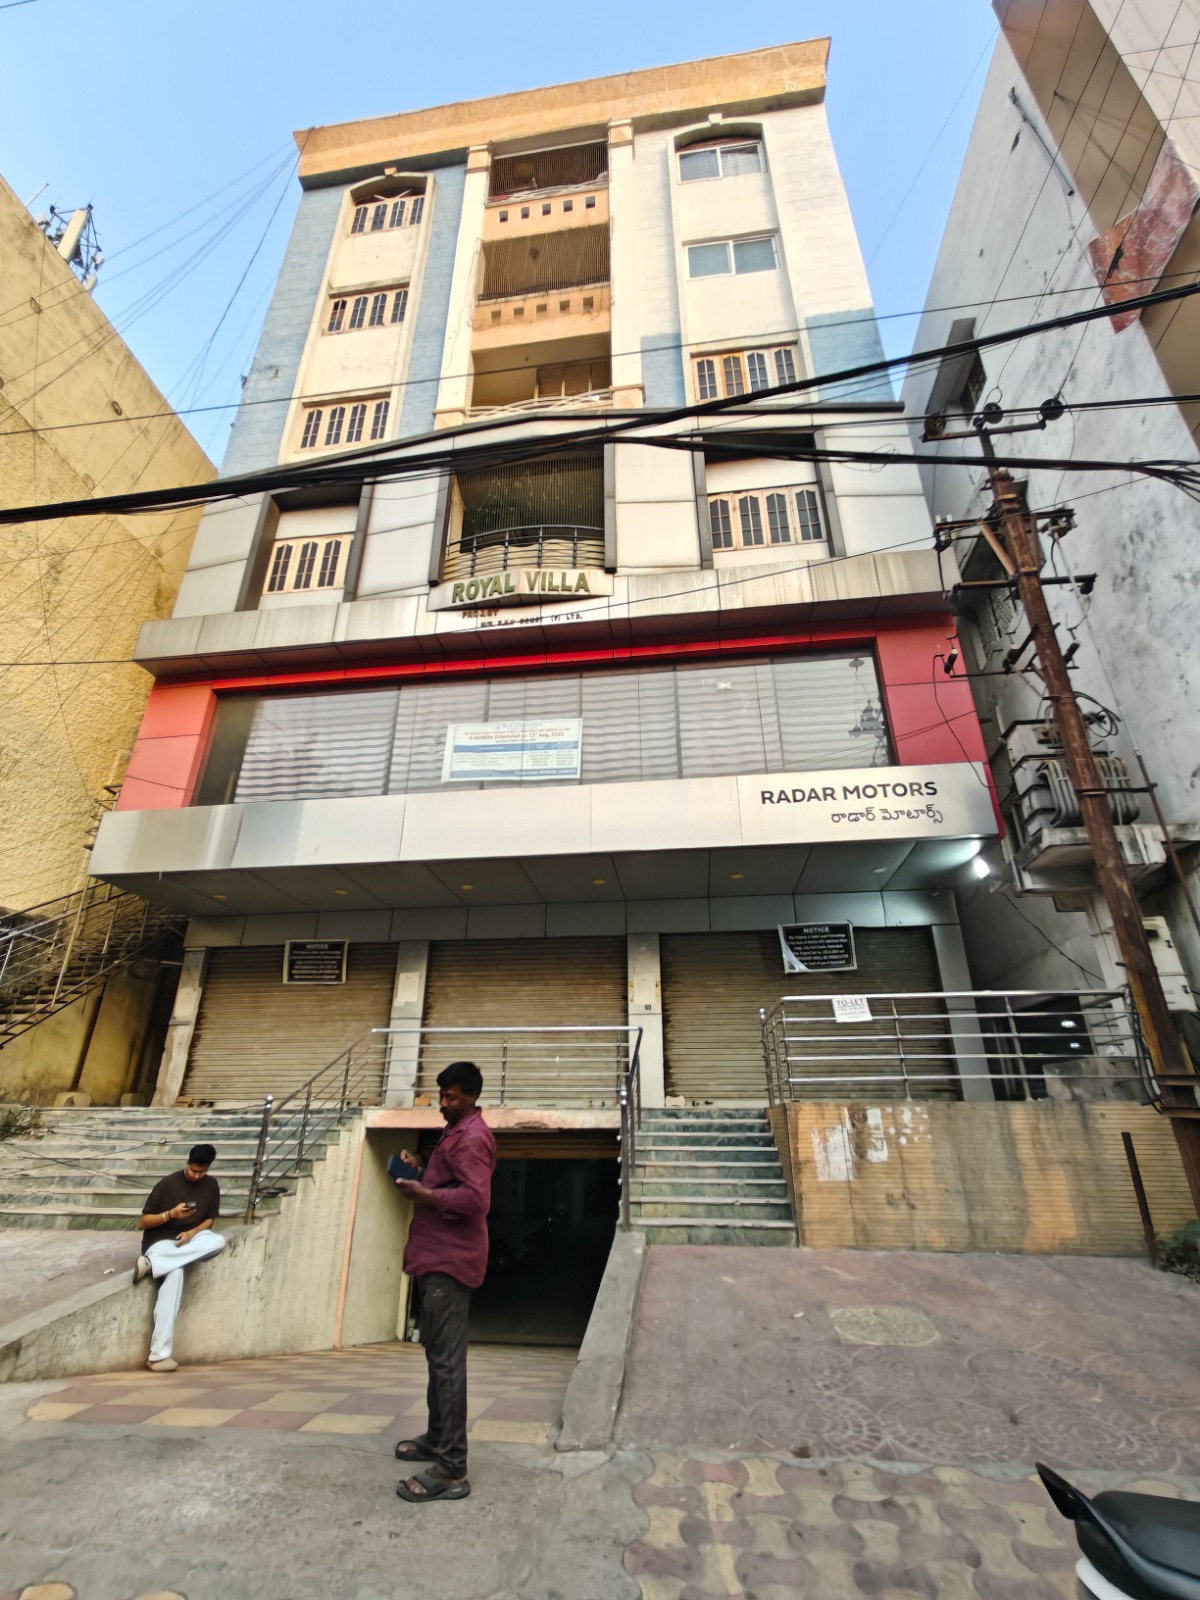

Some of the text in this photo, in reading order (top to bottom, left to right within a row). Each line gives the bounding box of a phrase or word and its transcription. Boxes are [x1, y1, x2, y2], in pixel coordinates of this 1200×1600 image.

[452, 571, 590, 603] ROYAL VILLA
[761, 781, 938, 804] RADAR MOTORS
[831, 807, 876, 823] రాడార్
